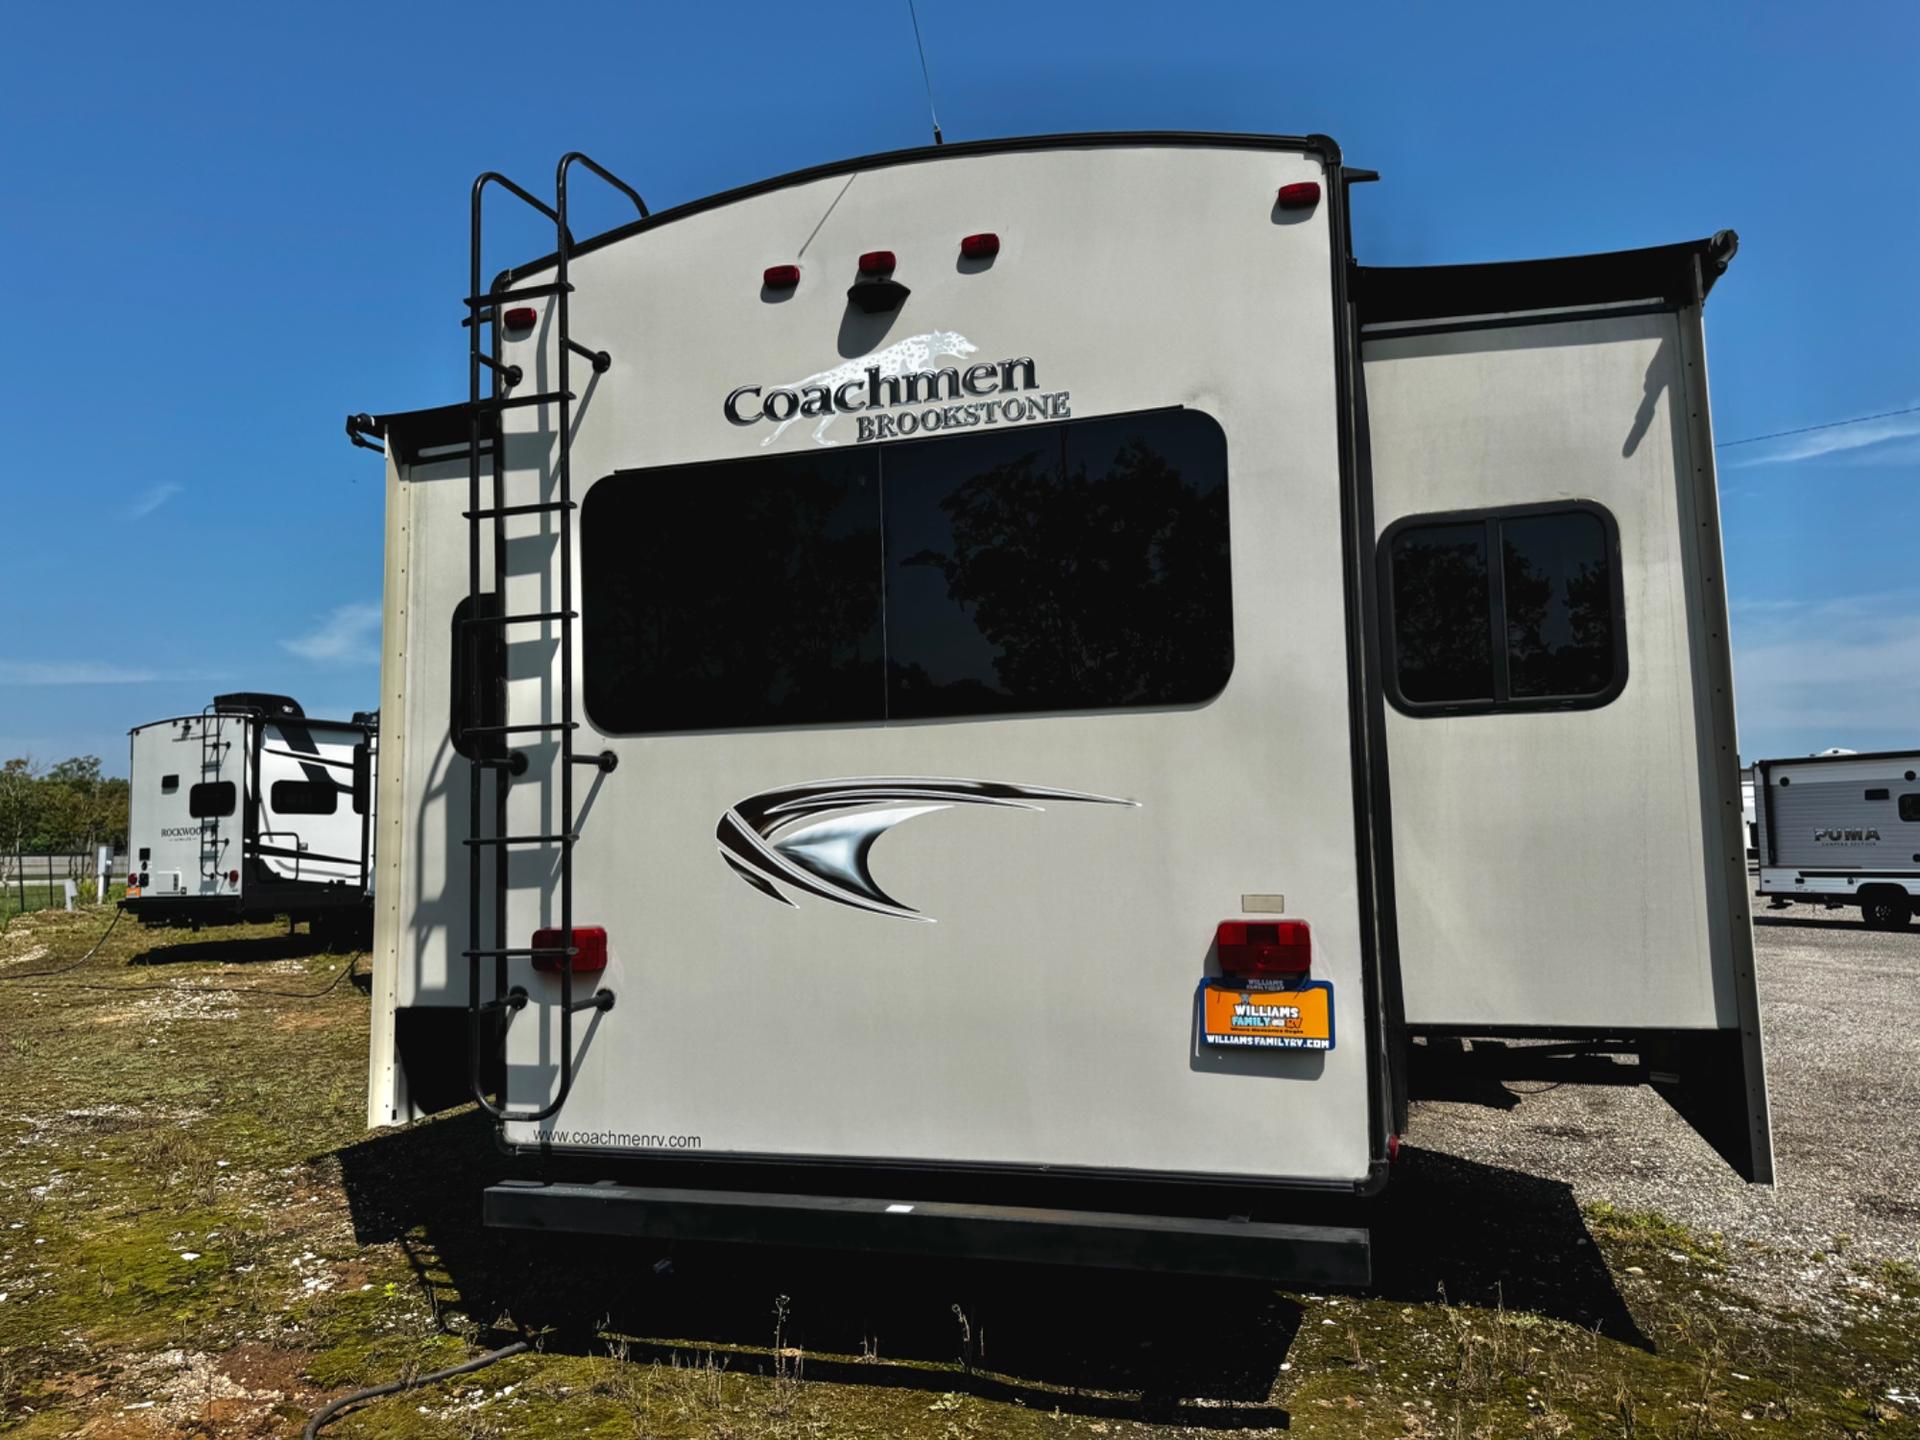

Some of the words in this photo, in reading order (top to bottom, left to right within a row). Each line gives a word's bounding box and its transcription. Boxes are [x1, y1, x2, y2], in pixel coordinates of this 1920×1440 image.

[724, 355, 1040, 426] Coachmen
[856, 391, 1071, 442] BROOKSTONE
[1814, 827, 1881, 841] PUMA
[1234, 1004, 1299, 1018] WILLIAMS
[1231, 1016, 1271, 1027] FAMILY
[533, 1130, 702, 1148] www.coachmenrv.com
